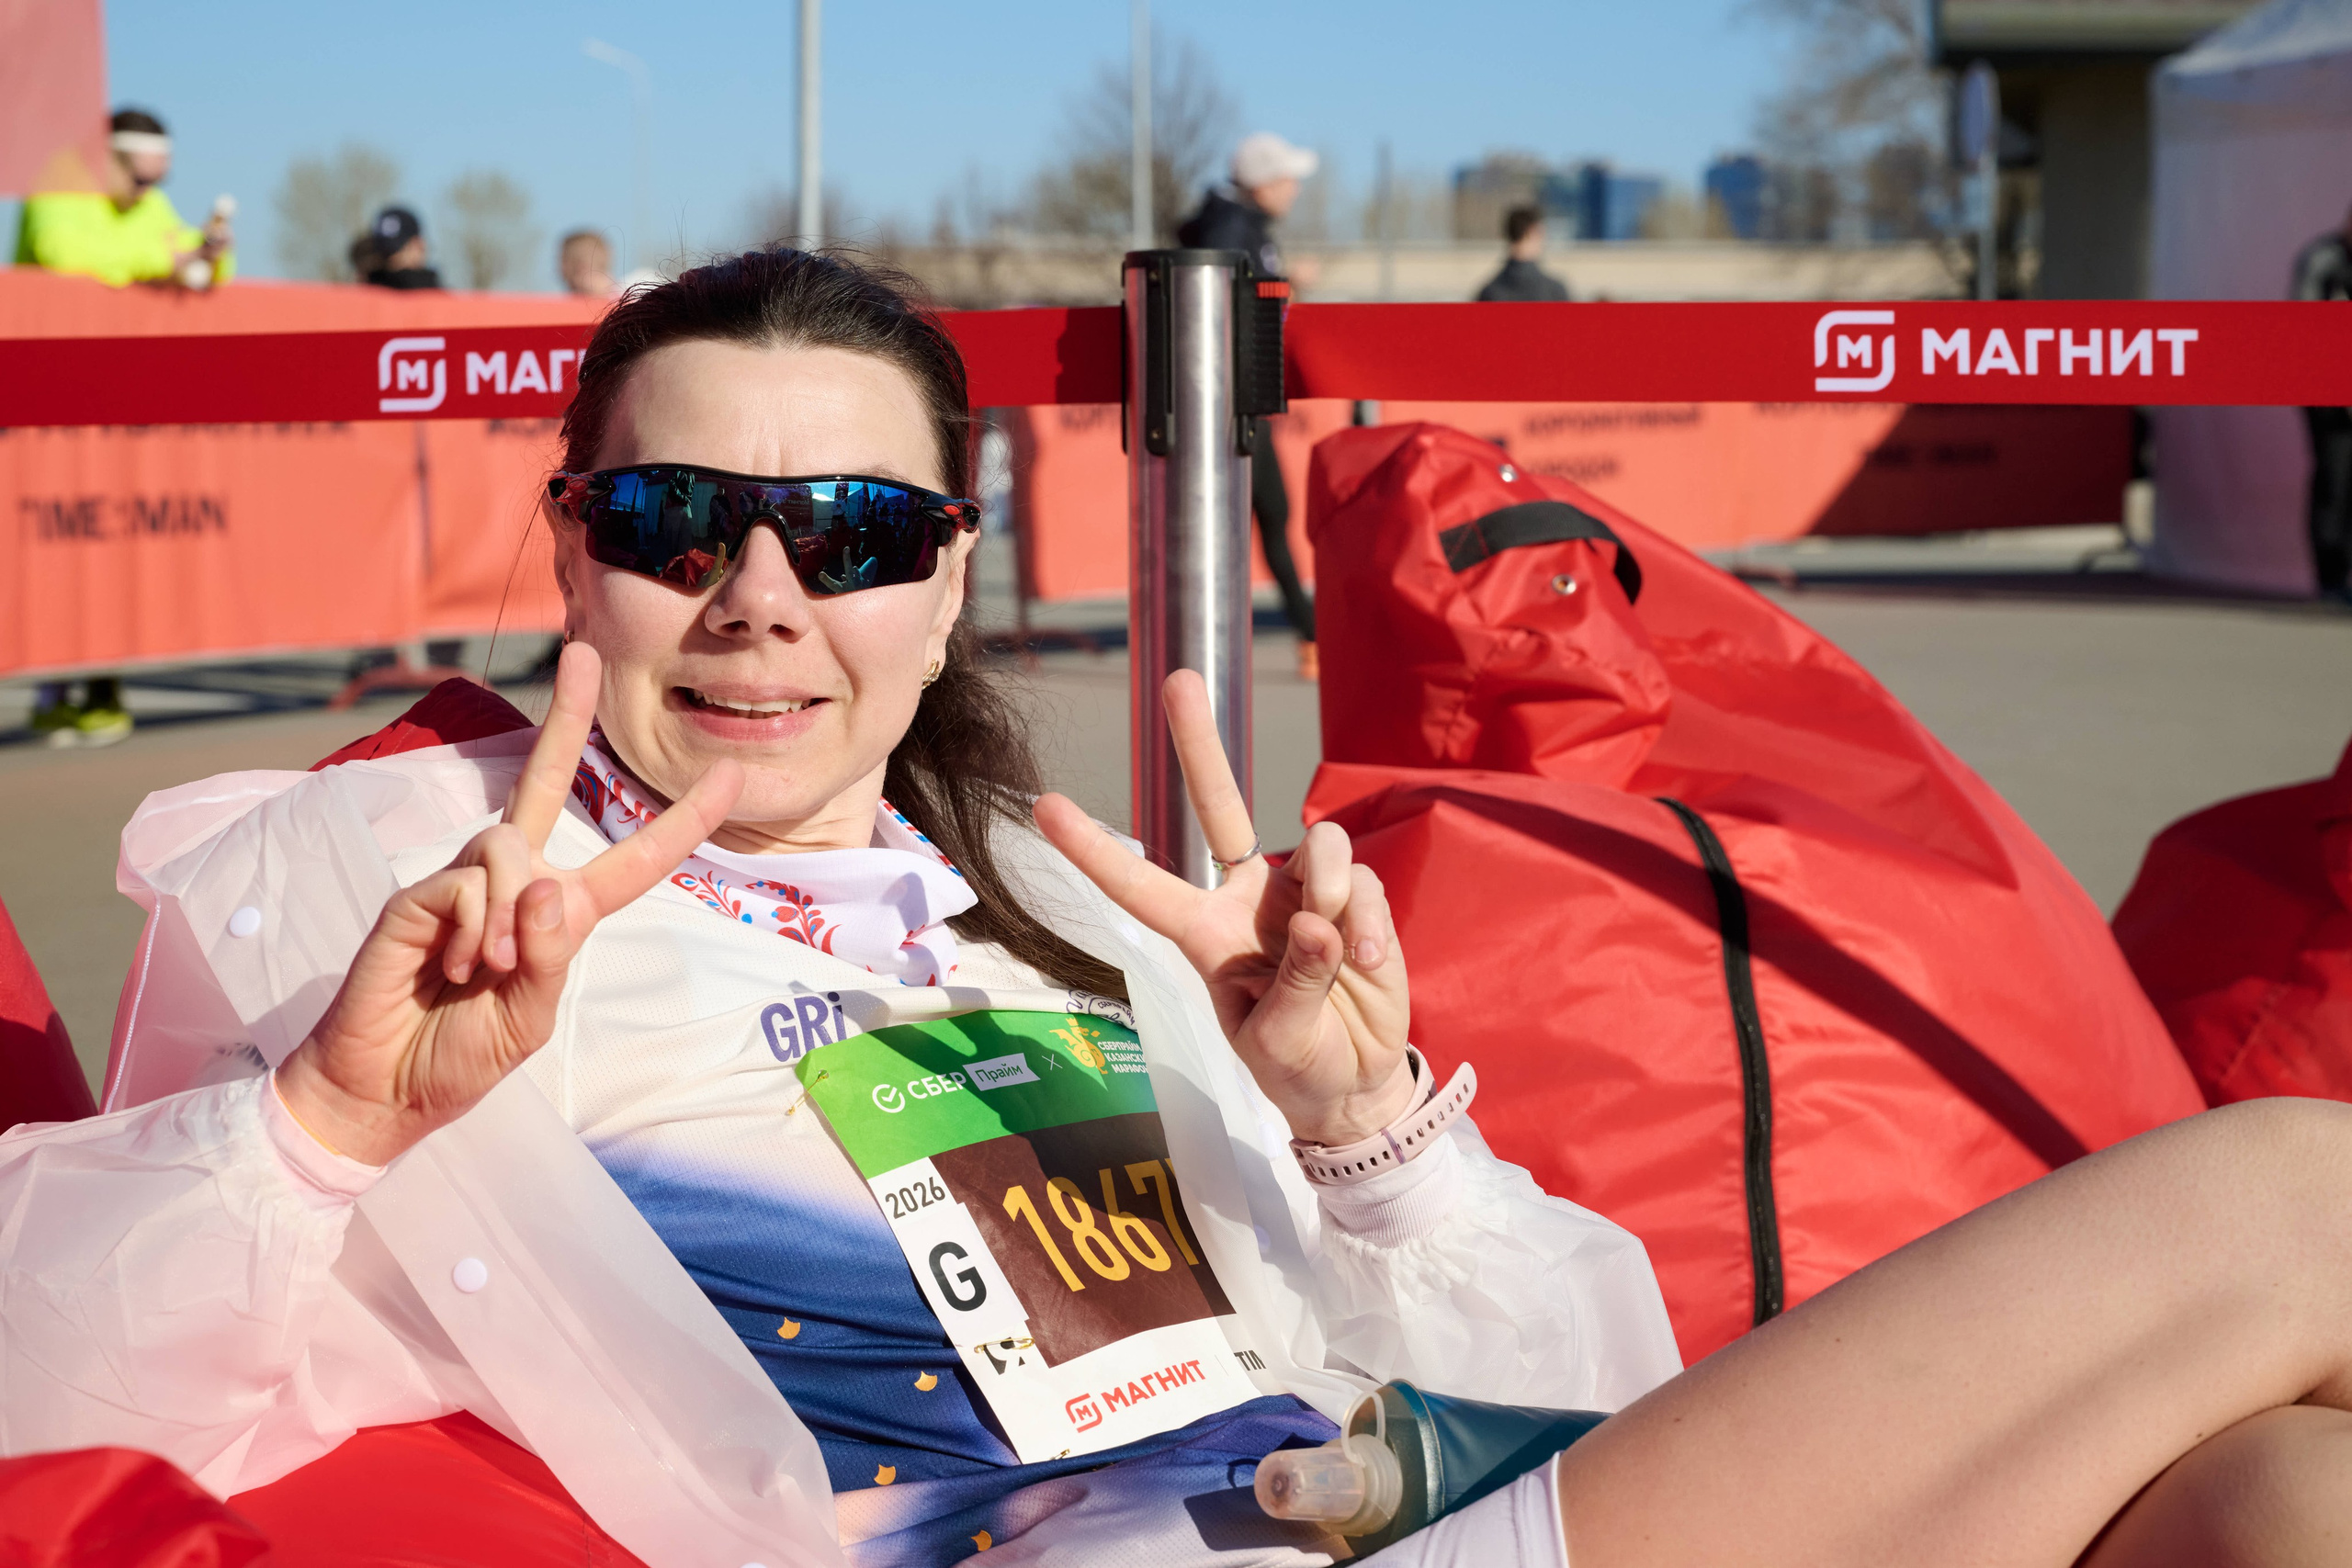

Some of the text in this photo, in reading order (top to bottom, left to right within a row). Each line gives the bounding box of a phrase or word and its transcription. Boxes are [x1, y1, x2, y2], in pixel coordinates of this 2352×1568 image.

[465, 348, 588, 395] МАГ
[1921, 328, 2199, 377] МАГНИТ
[907, 1063, 1024, 1101] СБЕР Прайм
[886, 1176, 945, 1220] 2026
[1002, 1156, 1200, 1292] 1867
[928, 1241, 988, 1312] G
[1100, 1359, 1206, 1415] МАГНИТ
